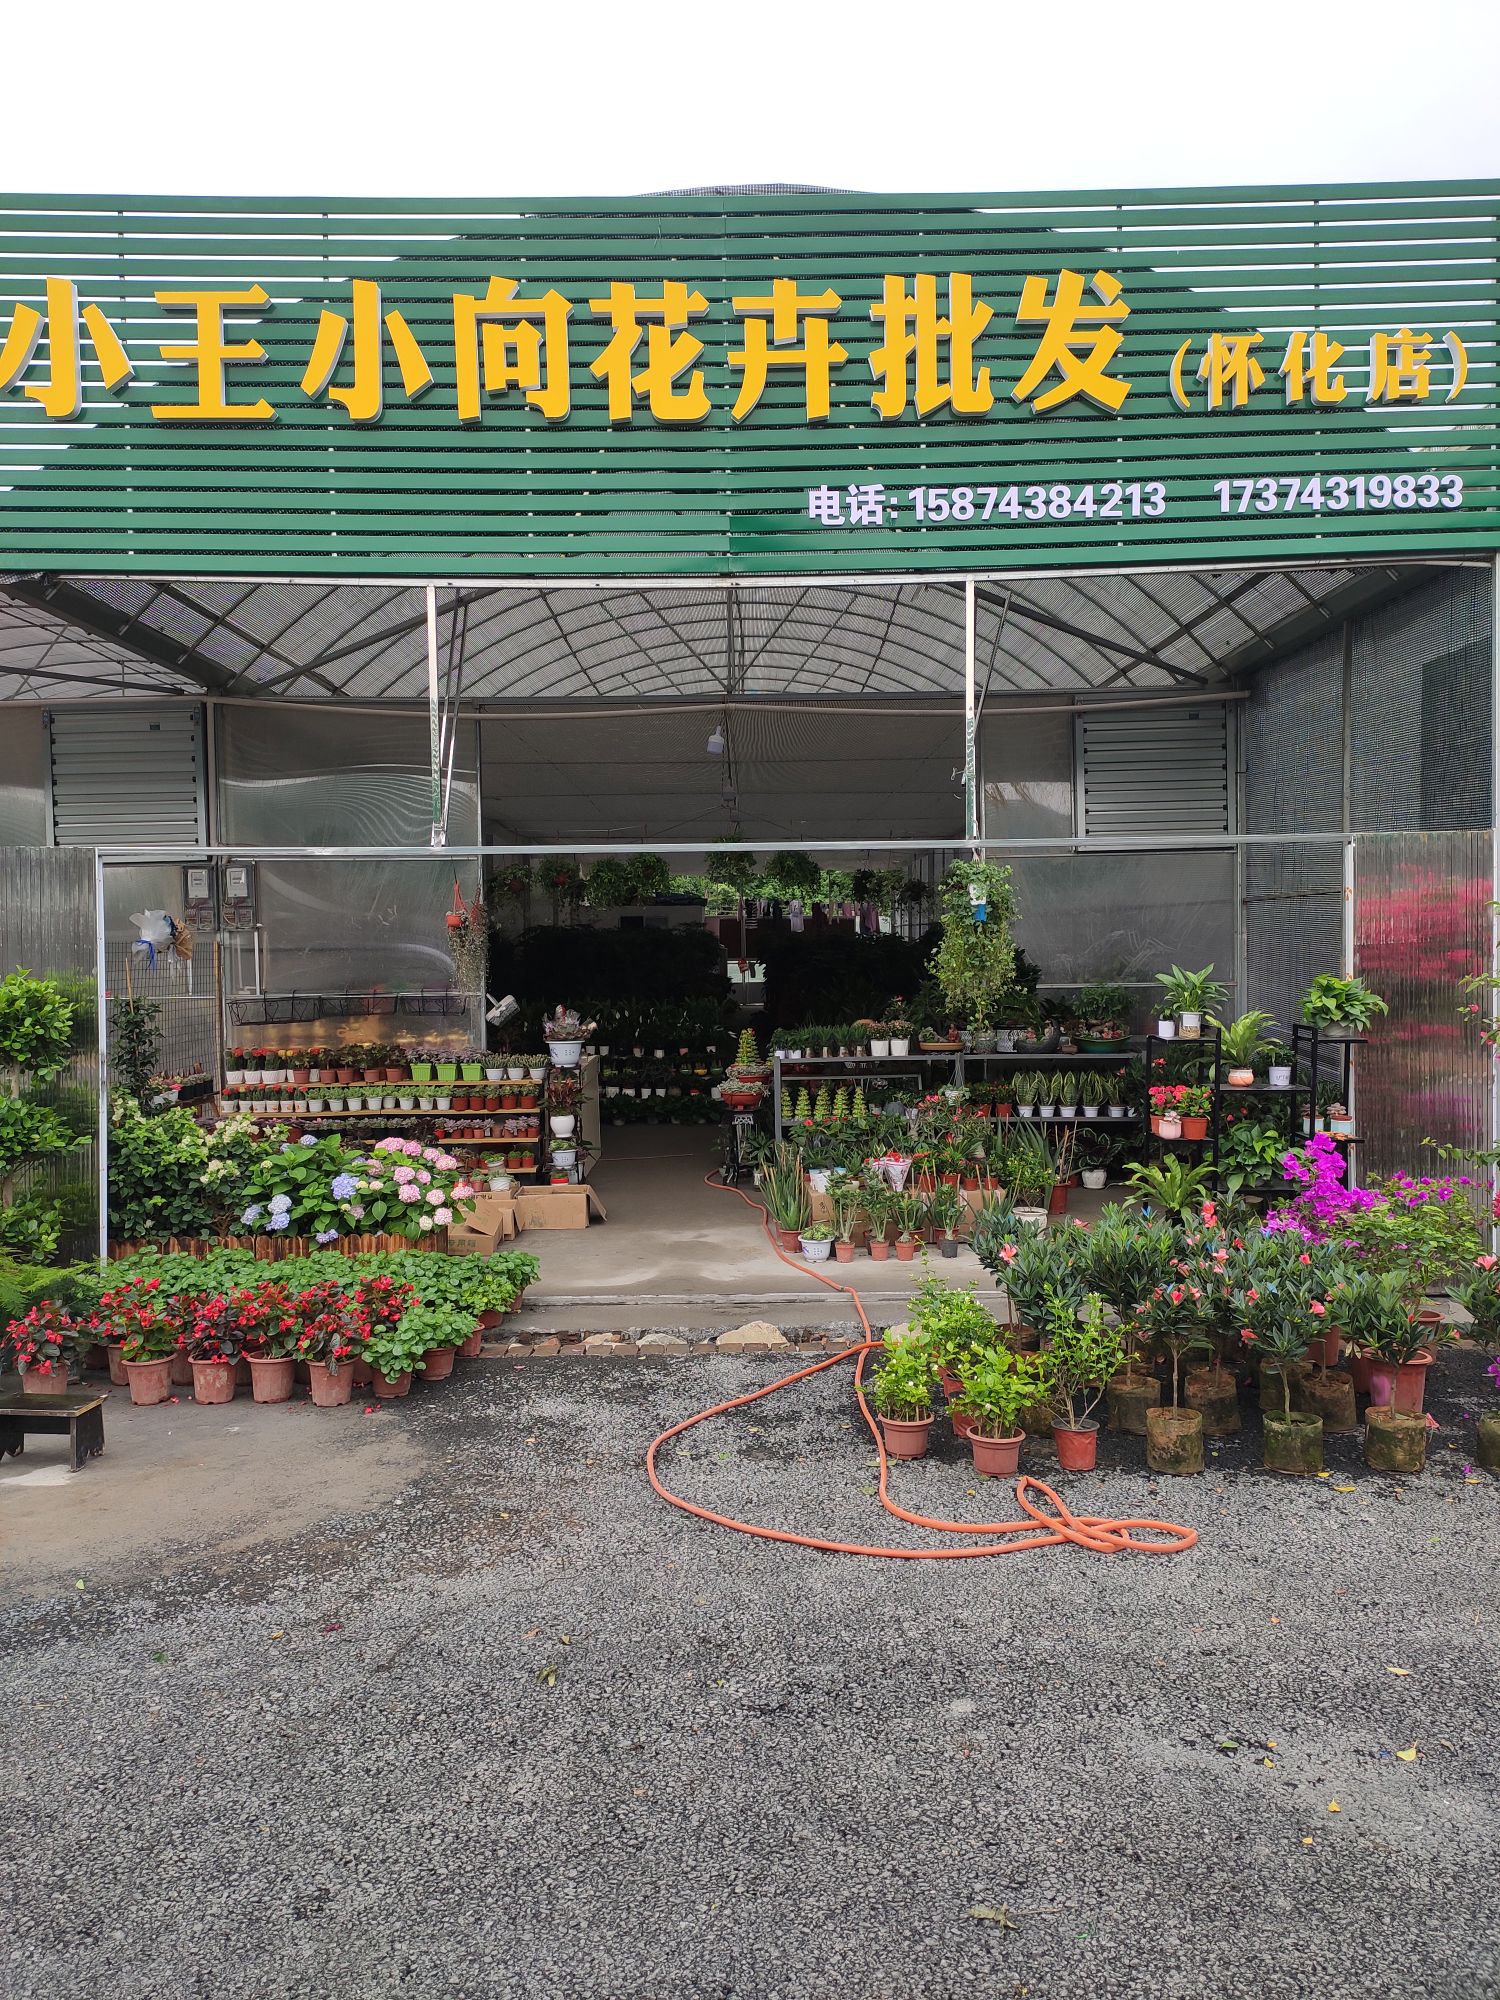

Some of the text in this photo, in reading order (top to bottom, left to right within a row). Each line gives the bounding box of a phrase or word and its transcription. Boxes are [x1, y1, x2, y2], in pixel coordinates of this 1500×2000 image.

[0, 269, 1133, 422] 小王小向花卉批发
[1169, 328, 1469, 411] (怀化店)
[1213, 474, 1465, 514] 17374319833
